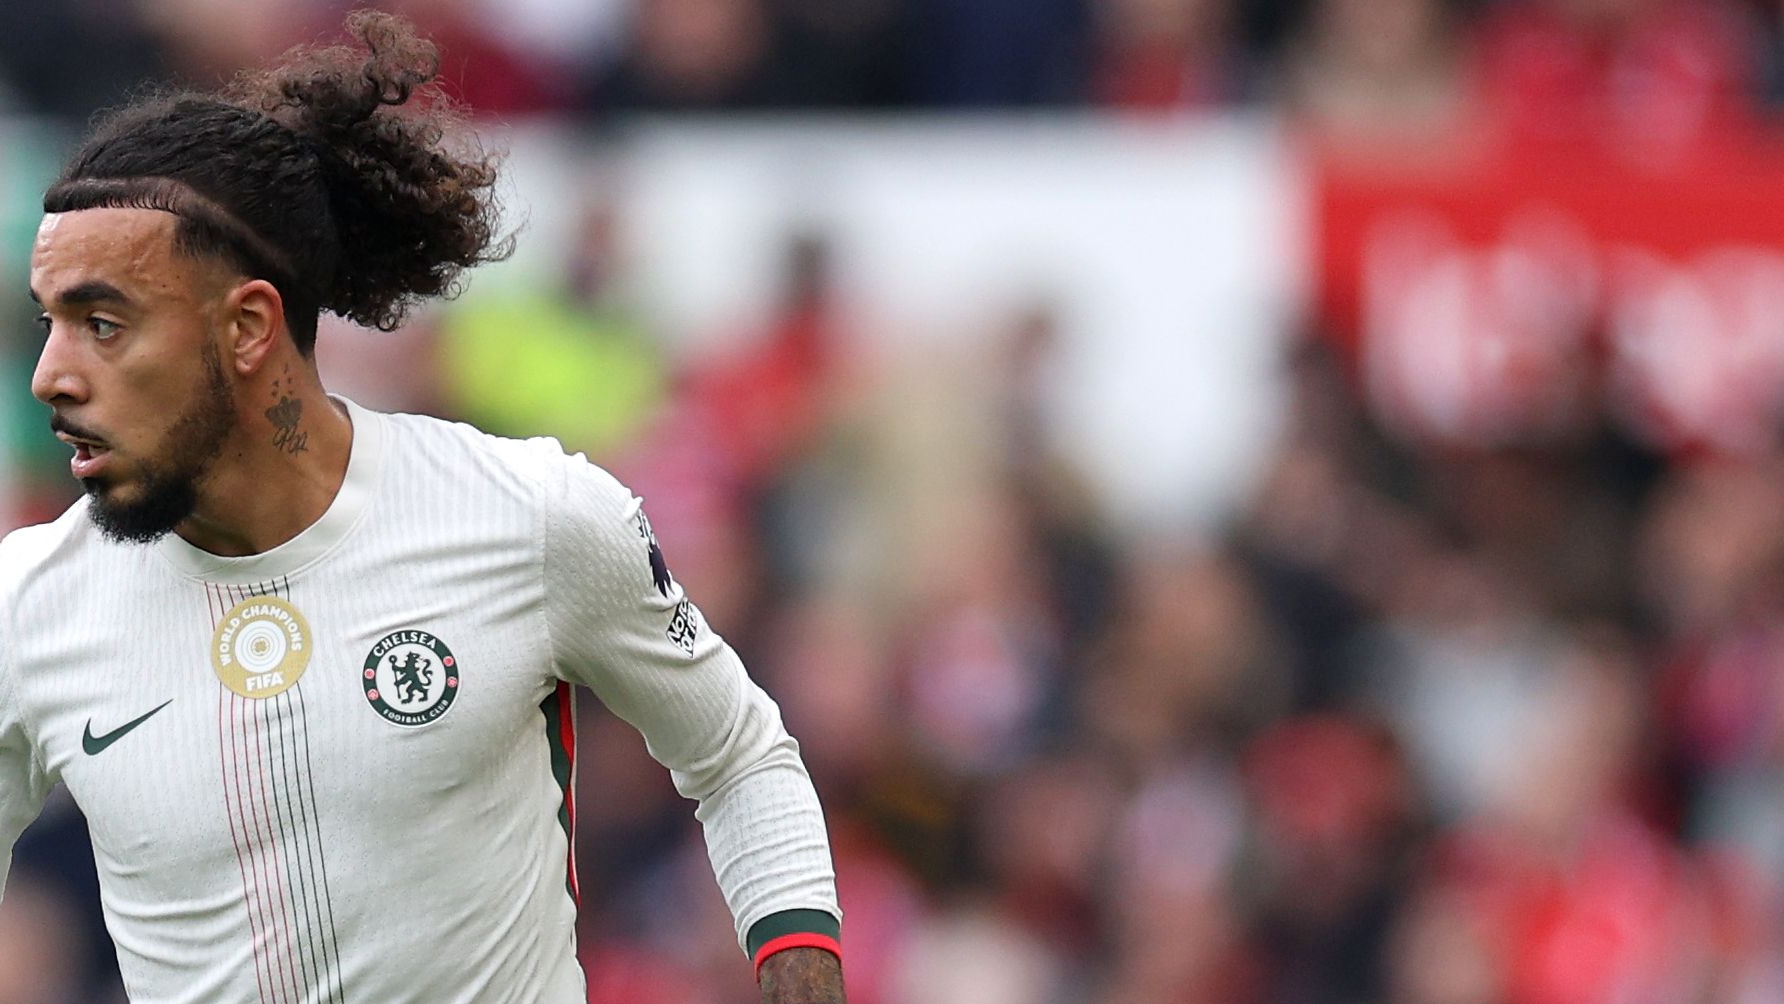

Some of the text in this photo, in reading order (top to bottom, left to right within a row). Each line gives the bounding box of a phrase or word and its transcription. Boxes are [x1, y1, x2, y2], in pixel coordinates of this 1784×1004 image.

[219, 604, 303, 666] WORLD CHAMPIONS
[373, 631, 436, 657] CHELSEA
[245, 671, 284, 691] FIFA
[383, 700, 449, 723] FOOTBALL CLUB
